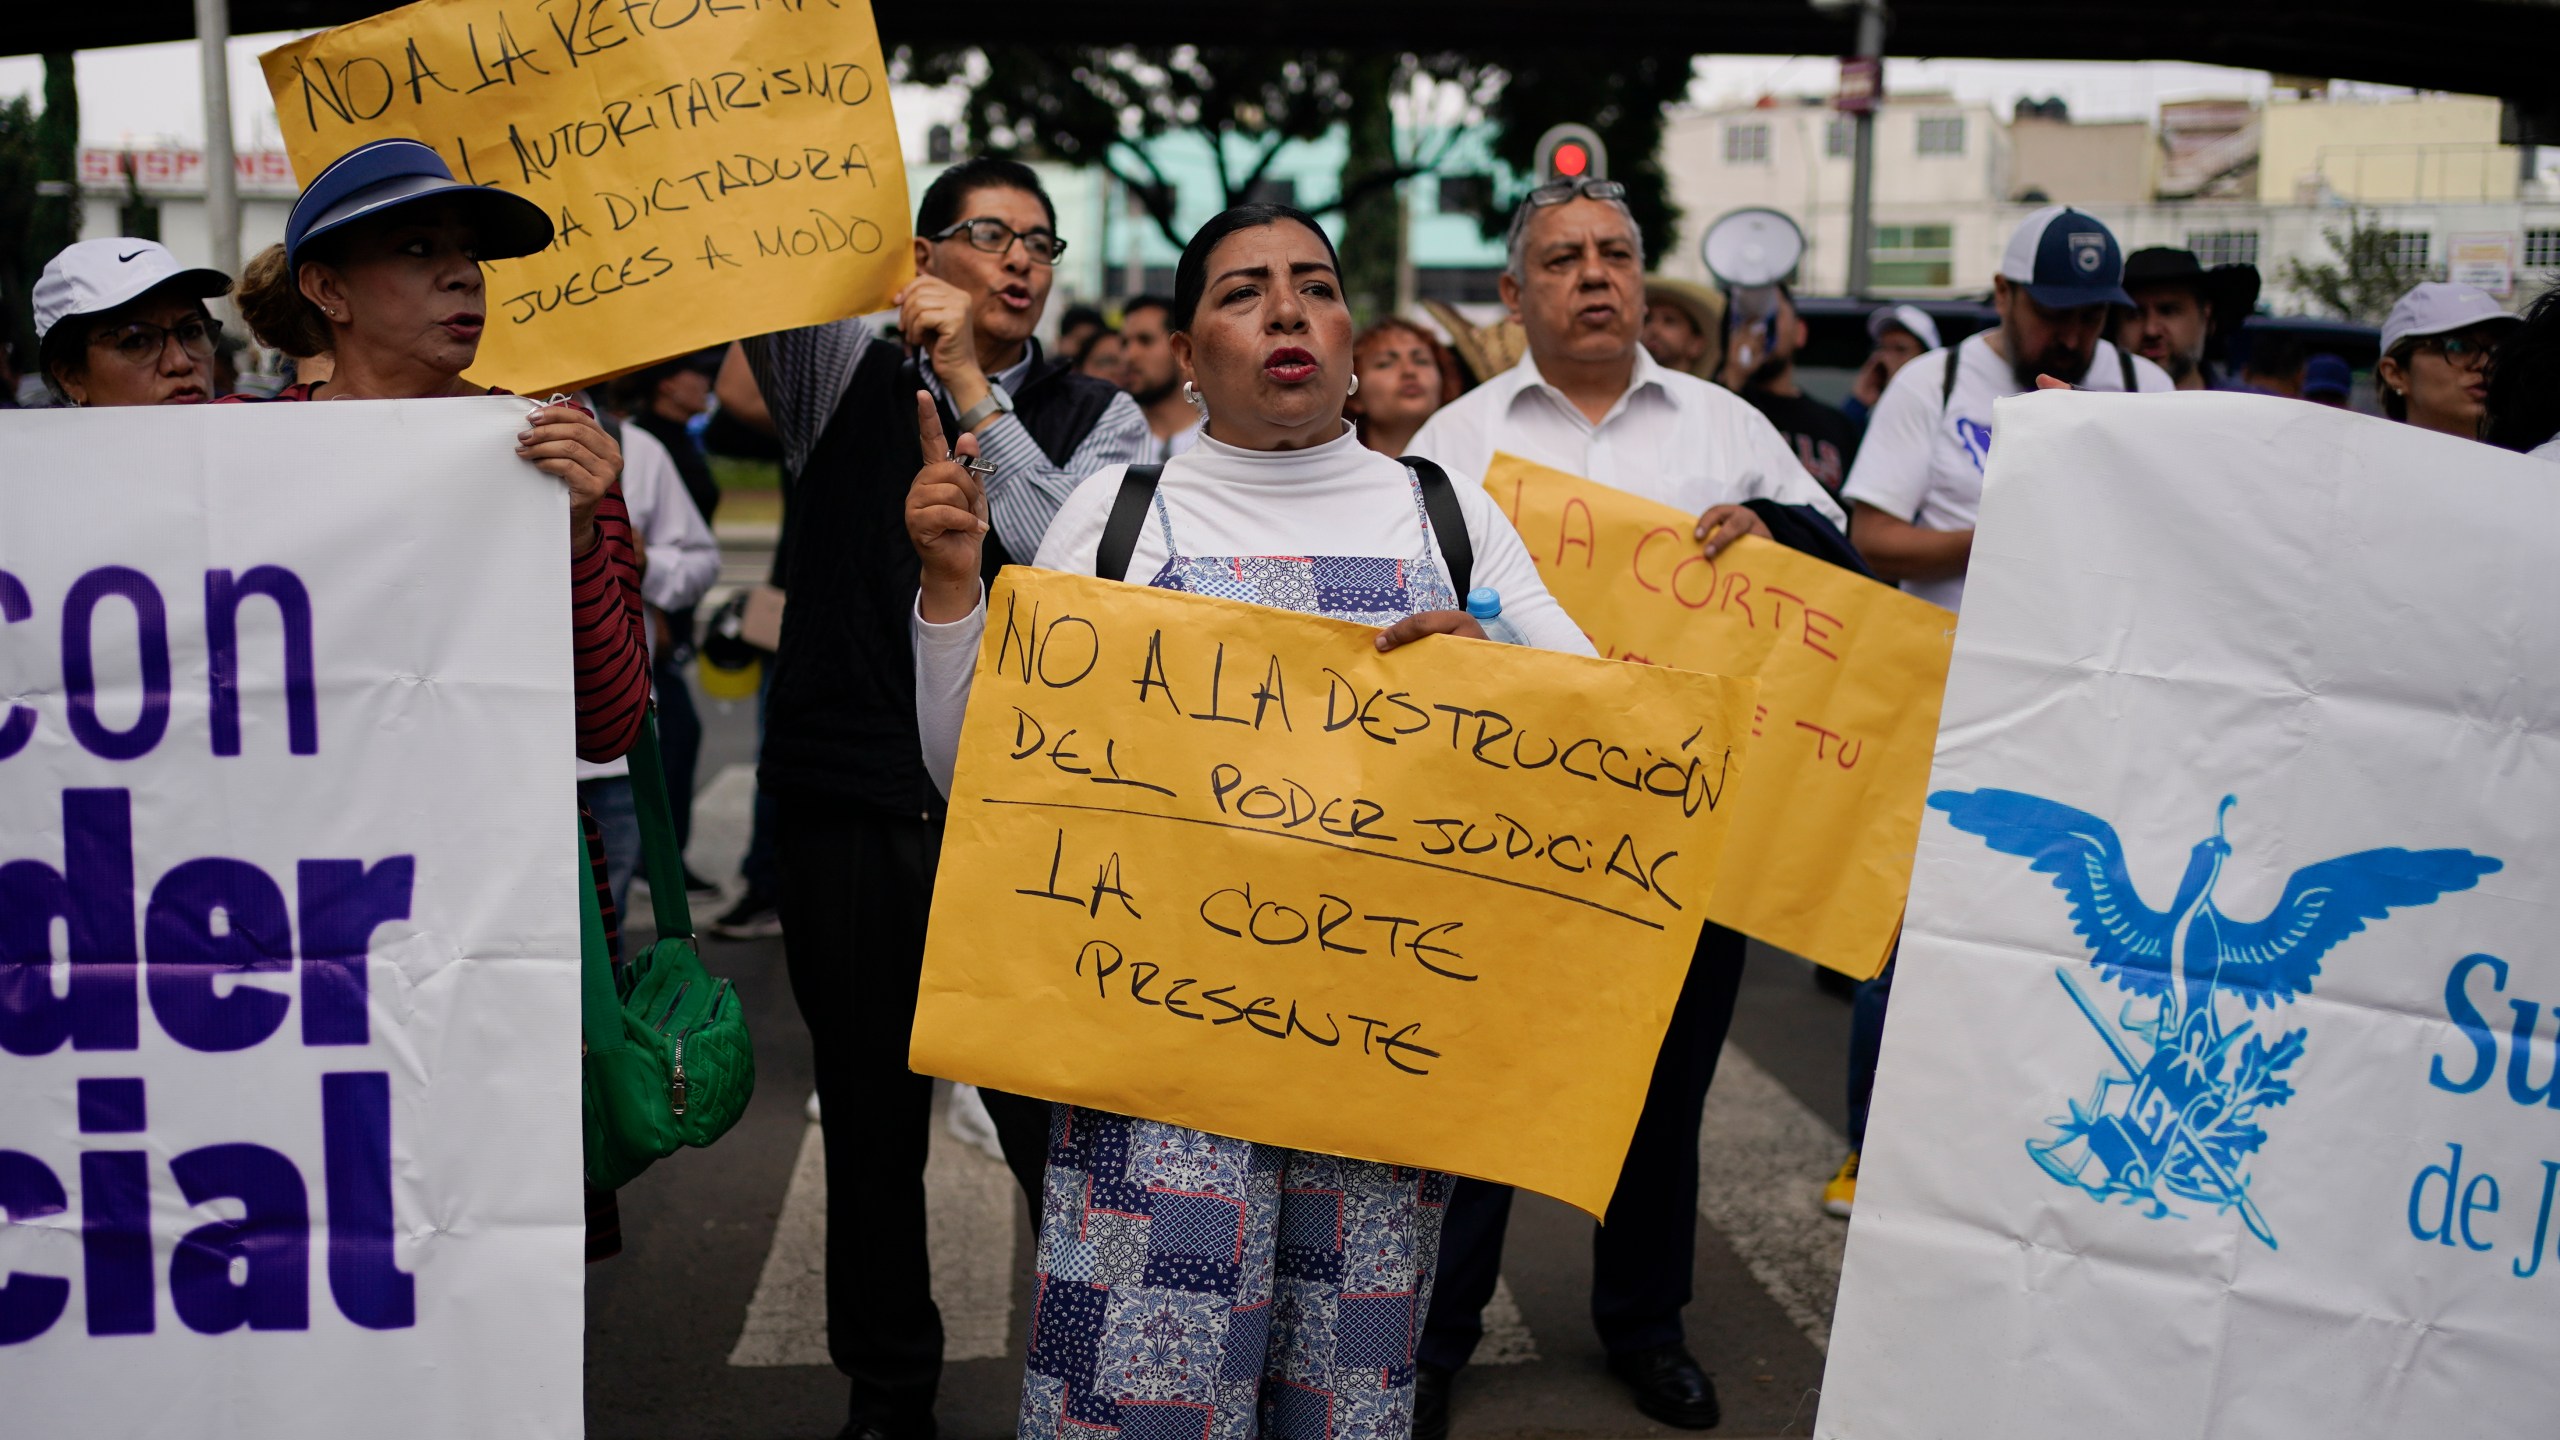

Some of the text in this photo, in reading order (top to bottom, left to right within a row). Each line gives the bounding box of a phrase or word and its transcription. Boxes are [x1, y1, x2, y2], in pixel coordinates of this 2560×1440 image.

[291, 56, 394, 132] NO
[404, 37, 459, 105] A
[465, 10, 551, 95] LA
[501, 208, 882, 324] JUECES A MODO
[997, 589, 1099, 688] NO
[1131, 628, 1181, 715] A
[1189, 641, 1293, 733] LA
[1633, 526, 1844, 661] CORTE
[1010, 705, 1178, 798] DEL
[1210, 762, 1398, 842] PODER
[1795, 719, 1863, 769] TU
[1015, 827, 1479, 982] LA CORTE
[1075, 939, 1443, 1075] PRESENTE
[2408, 1142, 2560, 1278] de J
